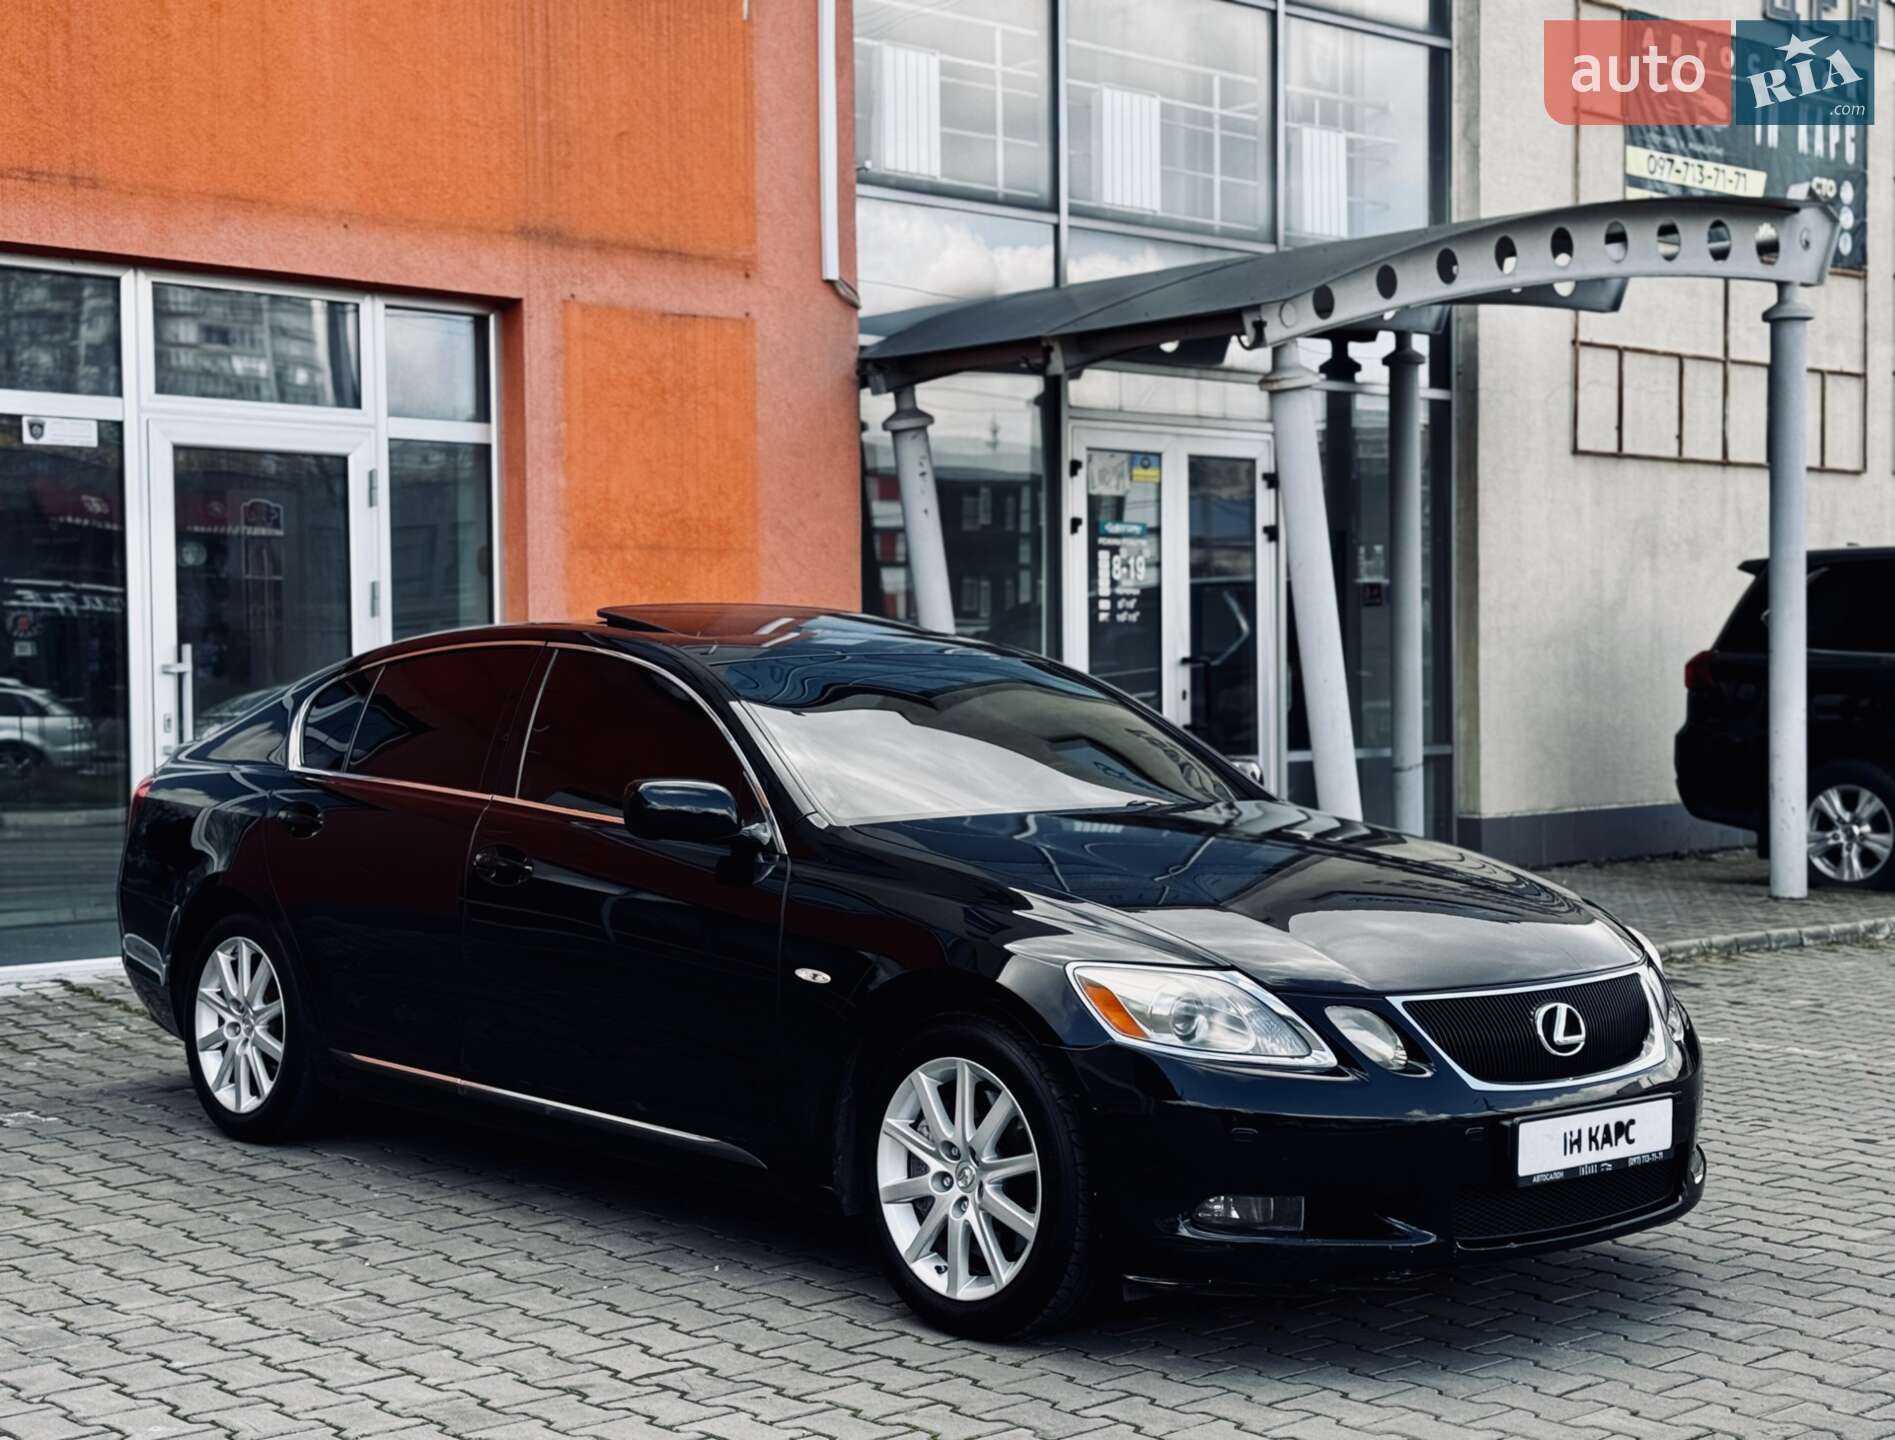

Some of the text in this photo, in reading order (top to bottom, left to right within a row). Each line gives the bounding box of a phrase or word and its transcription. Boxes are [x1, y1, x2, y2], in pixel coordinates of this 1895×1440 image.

[1646, 154, 1748, 193] 097-713-71-71
[1563, 1118, 1636, 1157] ІН КАРС
